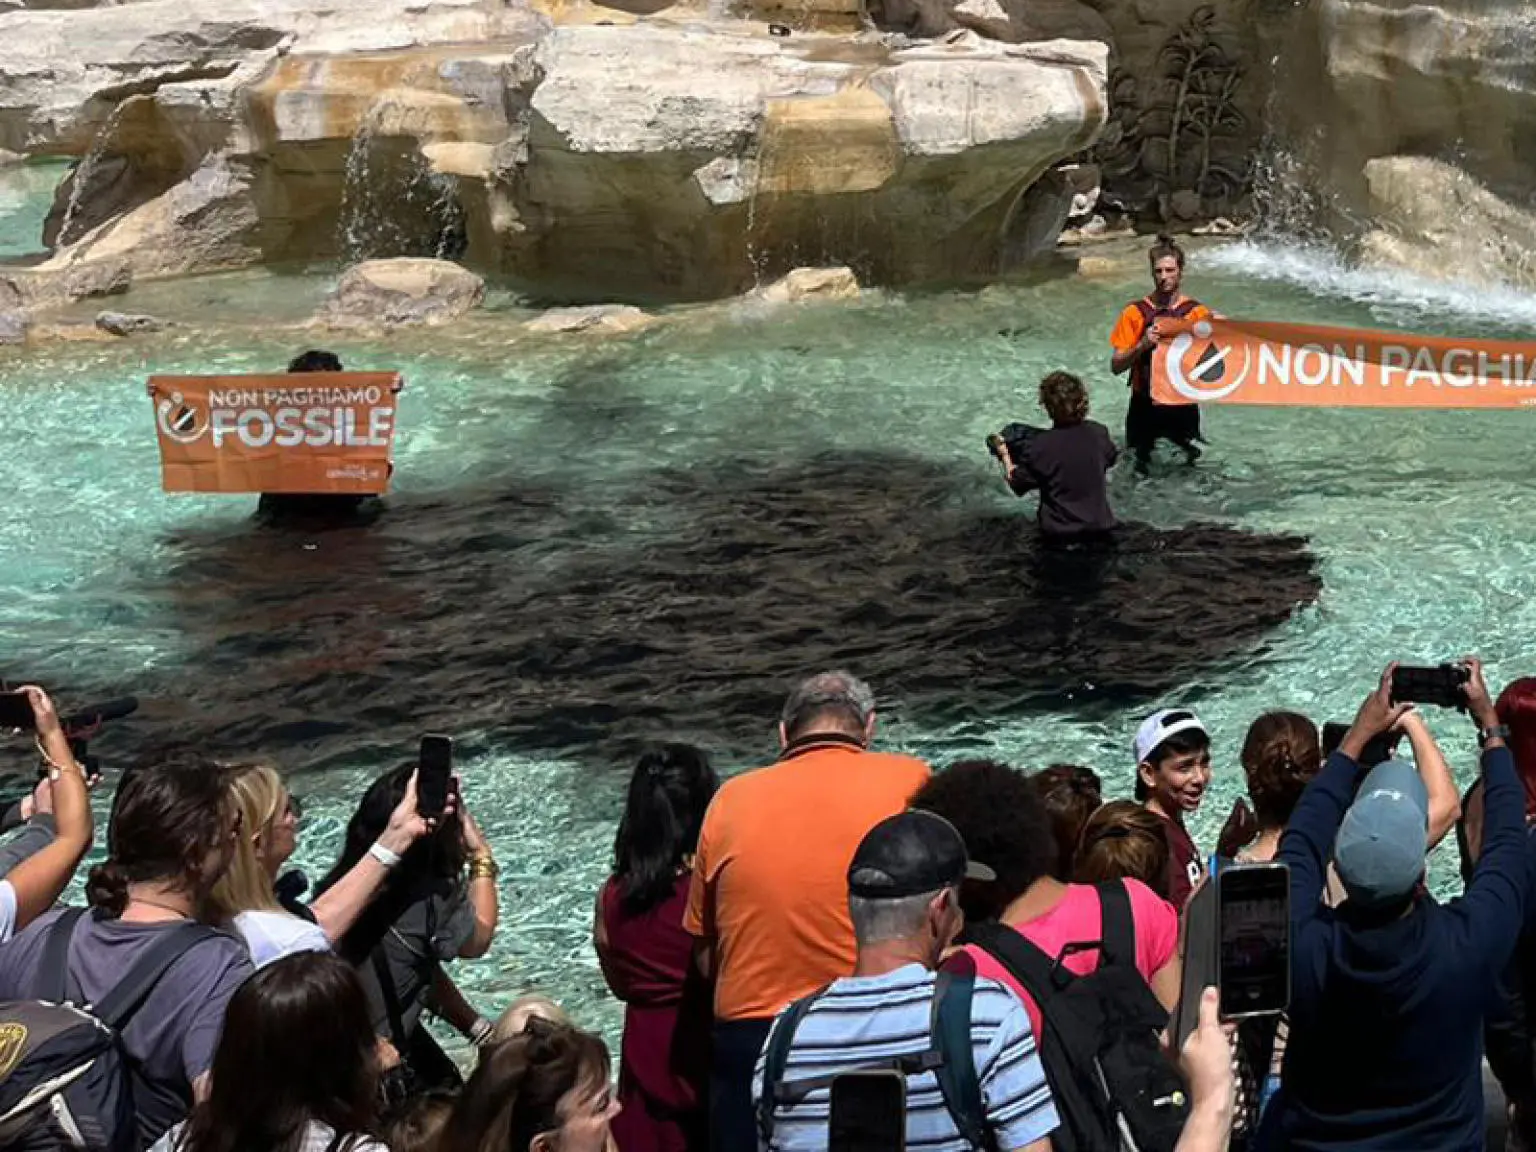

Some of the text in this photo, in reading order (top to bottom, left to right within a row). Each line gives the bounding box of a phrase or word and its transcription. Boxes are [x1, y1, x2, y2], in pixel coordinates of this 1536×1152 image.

[1257, 343, 1365, 387] NON
[208, 385, 381, 407] NON PAGHIAMO
[211, 408, 393, 448] FOSSILE
